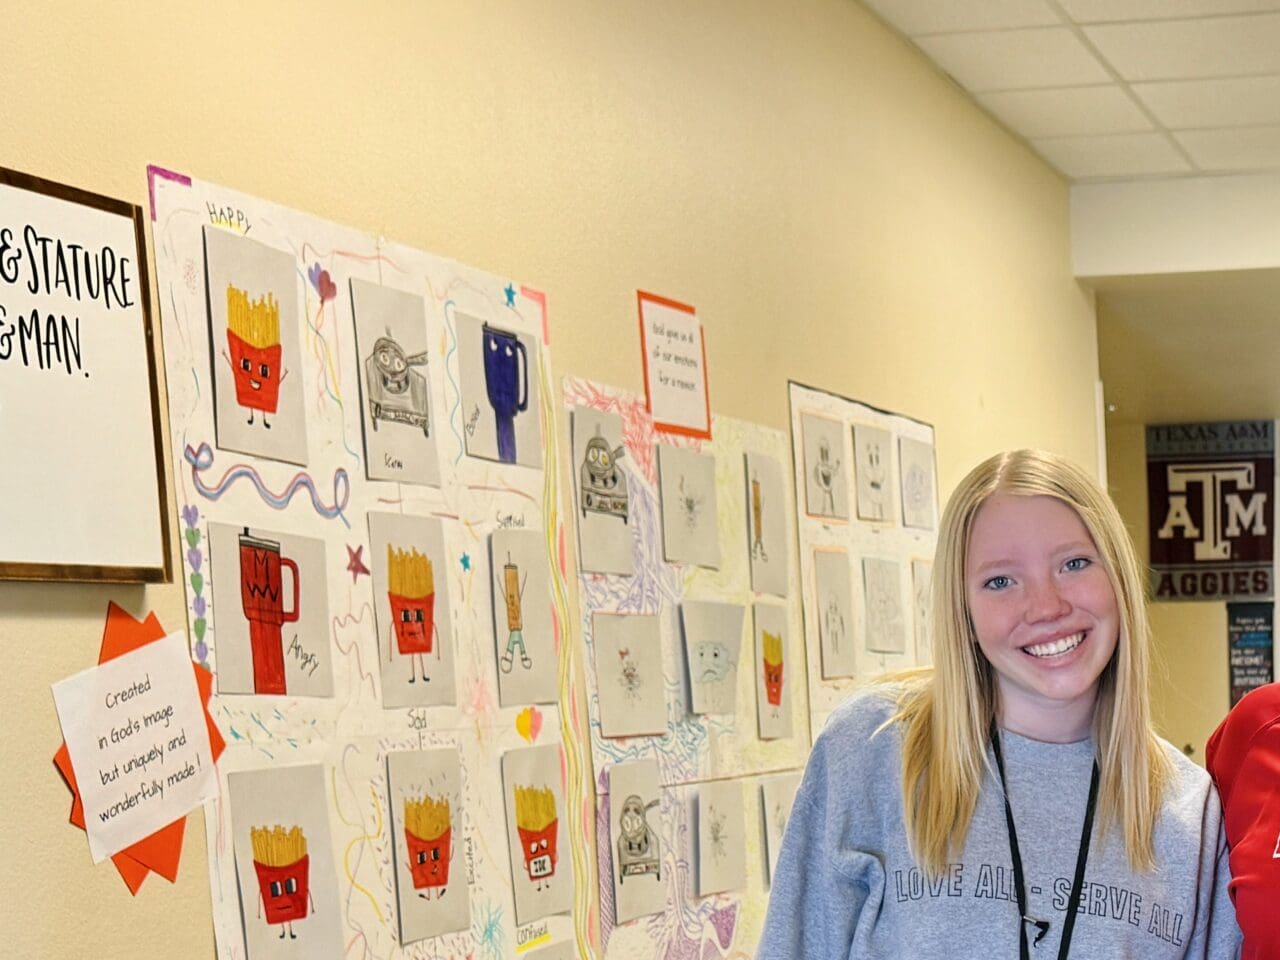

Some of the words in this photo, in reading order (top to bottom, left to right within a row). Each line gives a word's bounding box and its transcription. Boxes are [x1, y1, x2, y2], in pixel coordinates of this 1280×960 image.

[205, 200, 252, 235] HAPPY
[24, 224, 134, 310] STATURE
[18, 308, 89, 378] MAN.
[1154, 424, 1218, 442] TEXAS
[1157, 570, 1269, 597] AGGIES
[286, 633, 319, 677] Angry
[105, 673, 152, 709] Created
[407, 708, 427, 730] Sad
[98, 735, 108, 750] in
[99, 764, 120, 786] but
[122, 743, 164, 773] uniquely
[167, 728, 187, 752] and
[99, 779, 164, 823] wonderfully
[895, 863, 964, 903] LOVE
[975, 864, 1021, 904] ALL
[1053, 877, 1142, 926] SERVE
[1148, 903, 1183, 946] ALL
